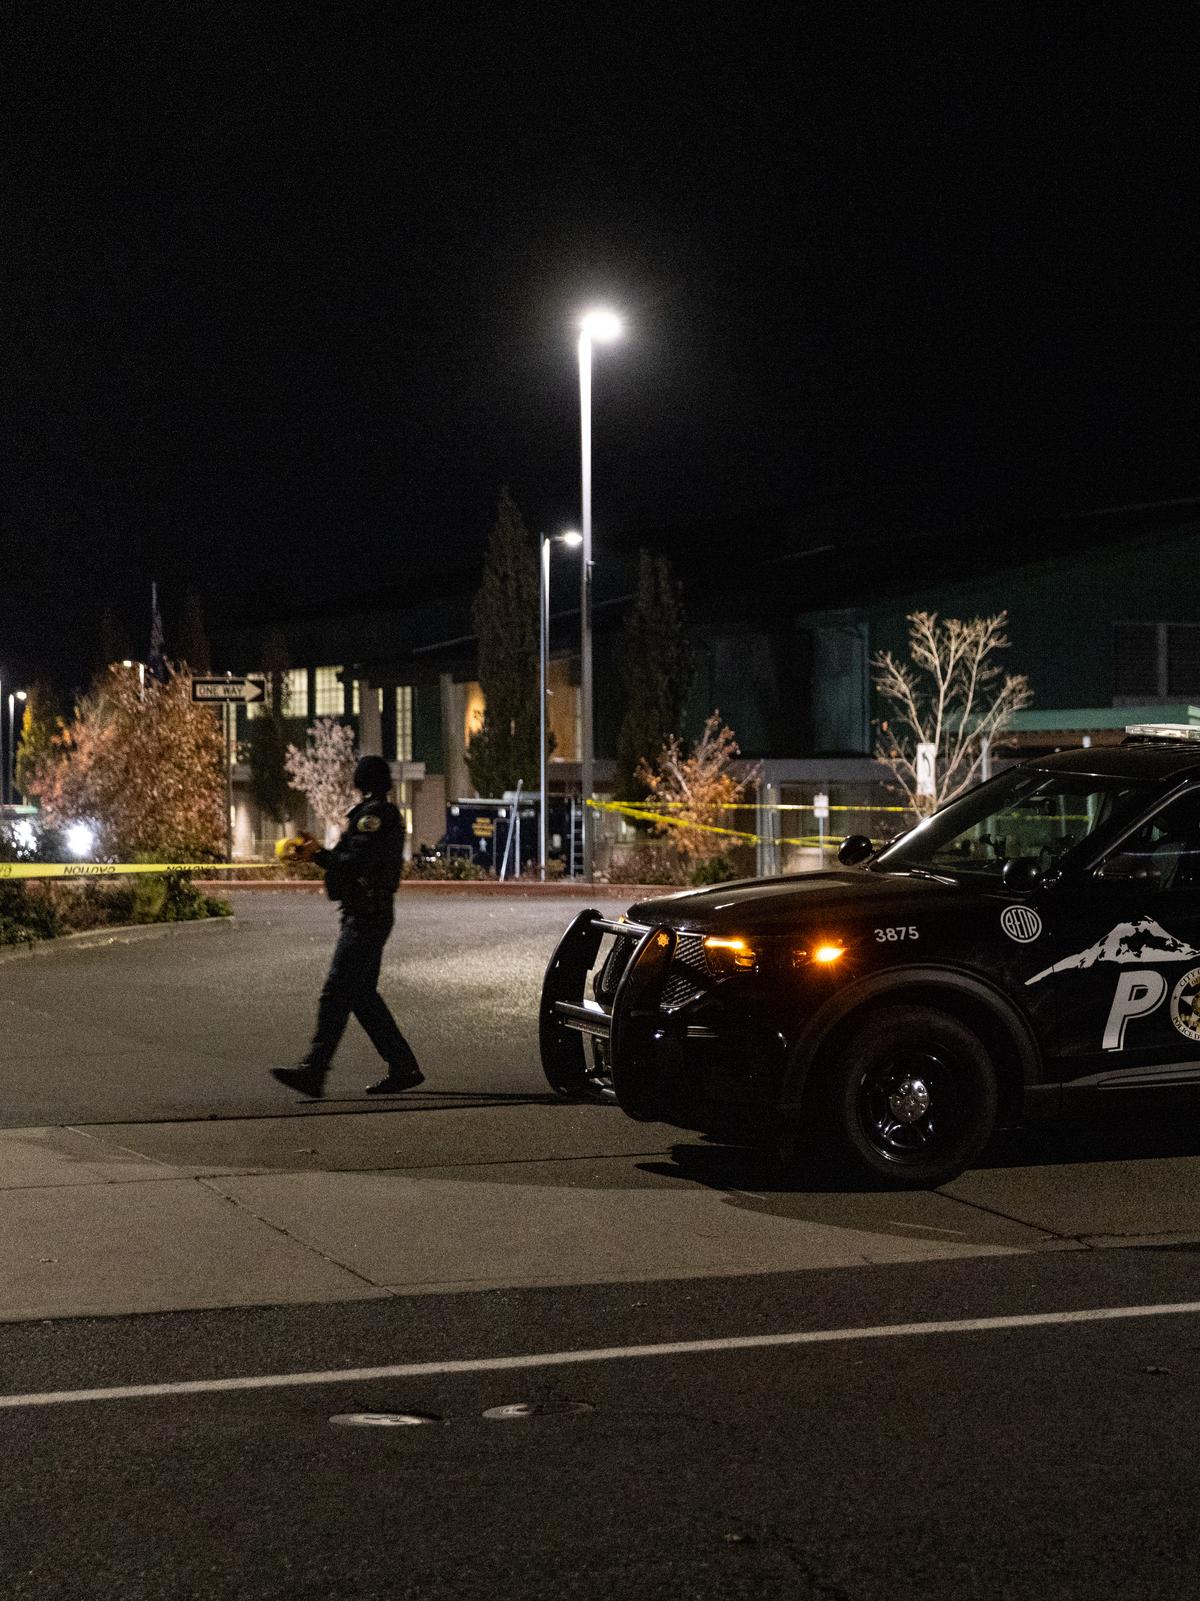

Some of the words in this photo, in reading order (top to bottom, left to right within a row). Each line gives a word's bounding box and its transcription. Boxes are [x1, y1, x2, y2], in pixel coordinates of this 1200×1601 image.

[199, 685, 217, 697] ONE
[223, 685, 242, 696] WAY
[63, 866, 116, 875] CAUTION
[1004, 907, 1039, 940] BEND
[873, 925, 920, 943] 3875
[1179, 971, 1196, 987] CITY
[1172, 1016, 1193, 1038] POLICE
